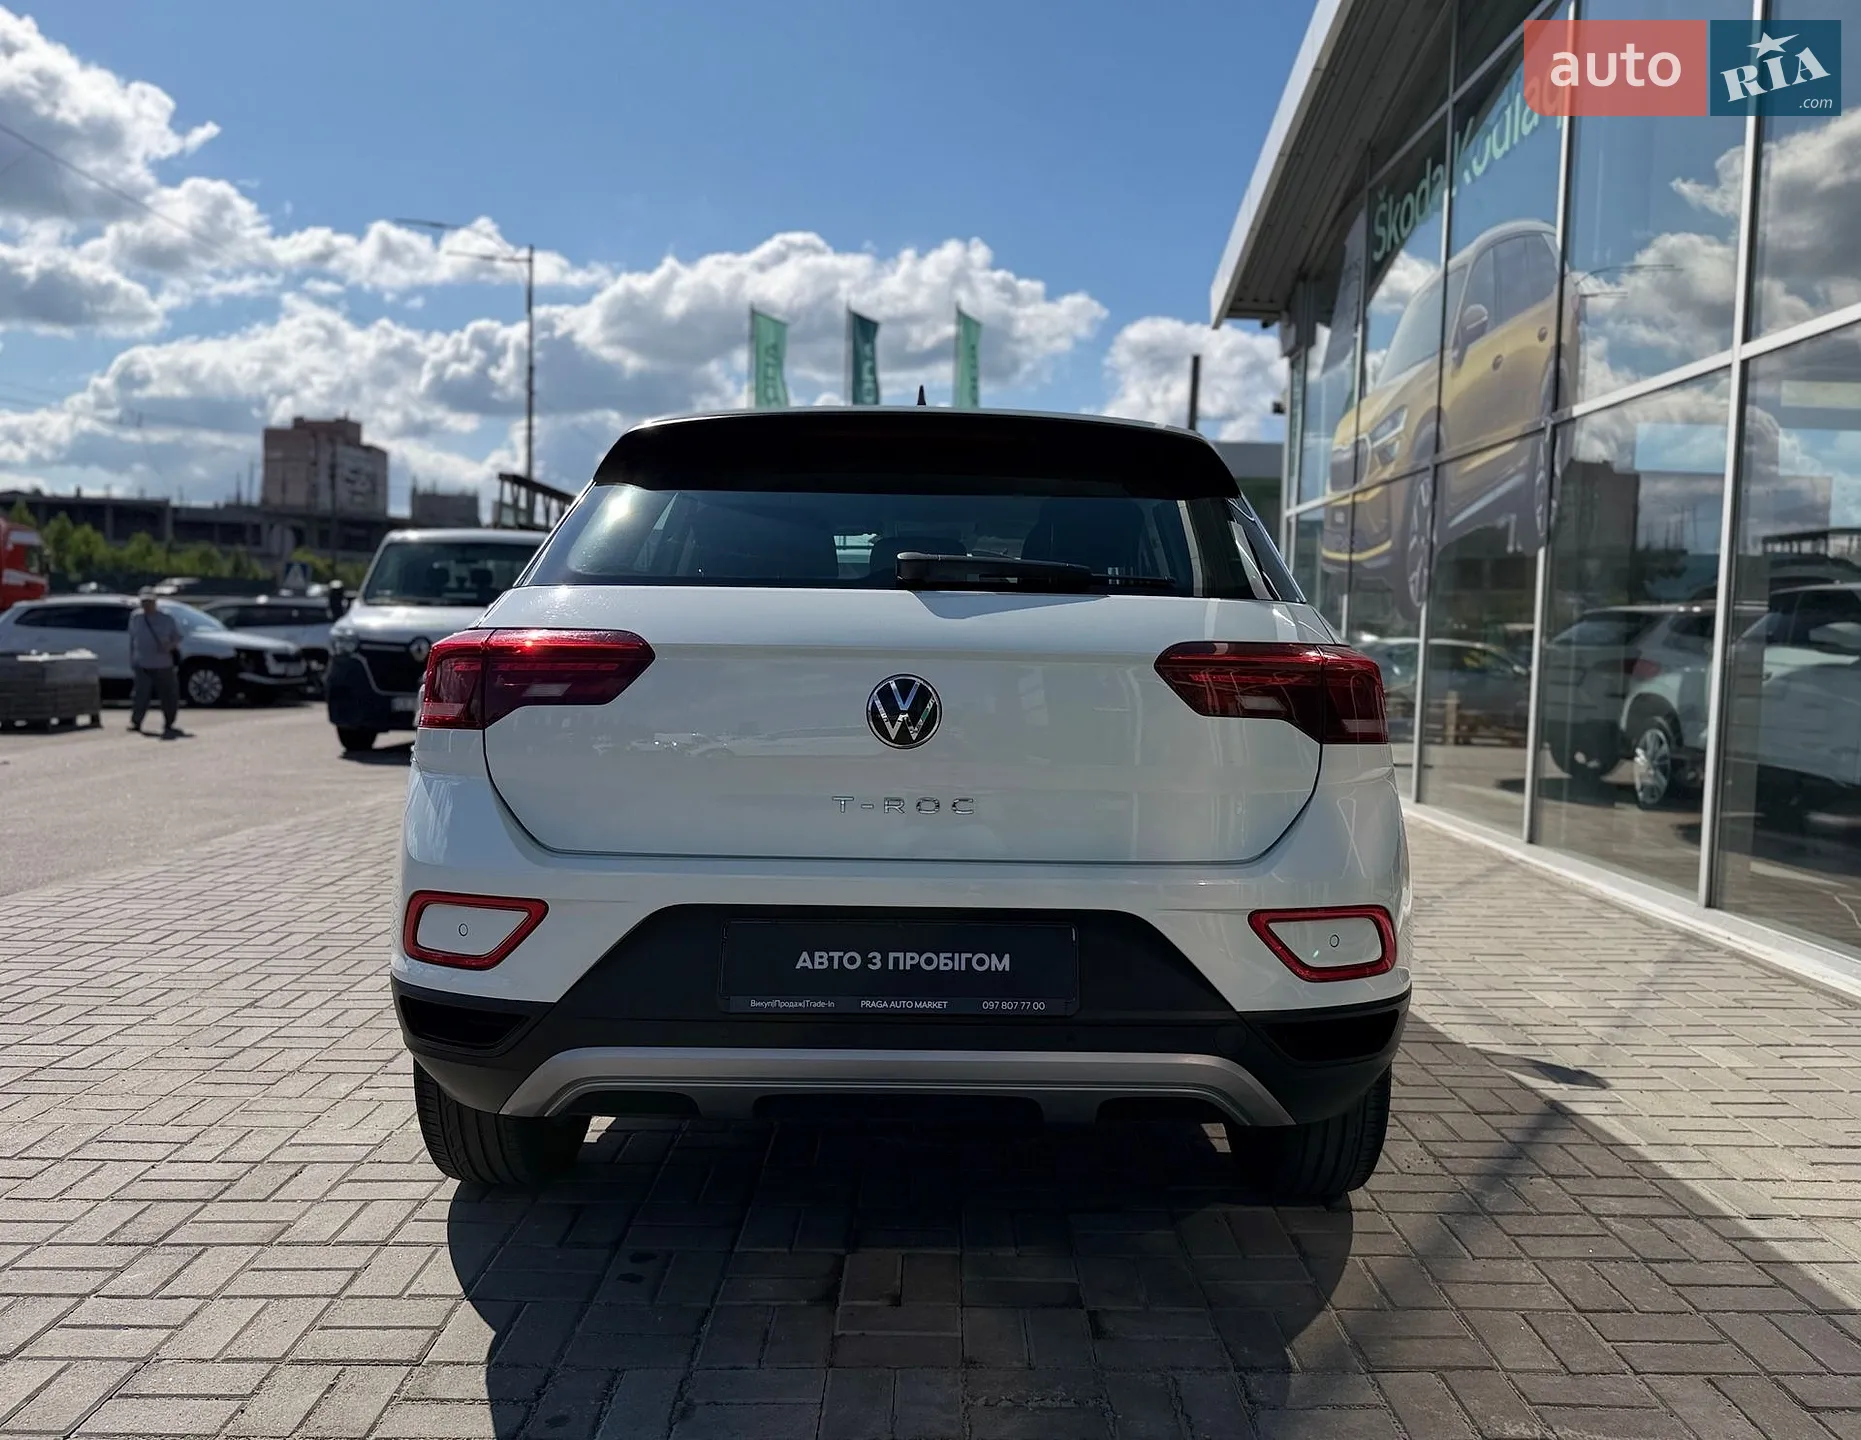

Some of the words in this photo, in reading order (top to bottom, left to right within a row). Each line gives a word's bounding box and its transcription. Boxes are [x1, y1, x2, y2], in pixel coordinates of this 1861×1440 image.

[832, 796, 974, 815] T-ROC
[795, 951, 862, 970] АВТО
[888, 952, 1010, 972] ПРОБІГОМ
[860, 1000, 888, 1009] PRAGA
[889, 1000, 913, 1010] AUTO
[914, 1000, 948, 1010] MARKET
[982, 1001, 999, 1011] 097
[1001, 1001, 1019, 1011] 807
[1020, 1001, 1031, 1011] 77
[1032, 1001, 1046, 1011] 00
